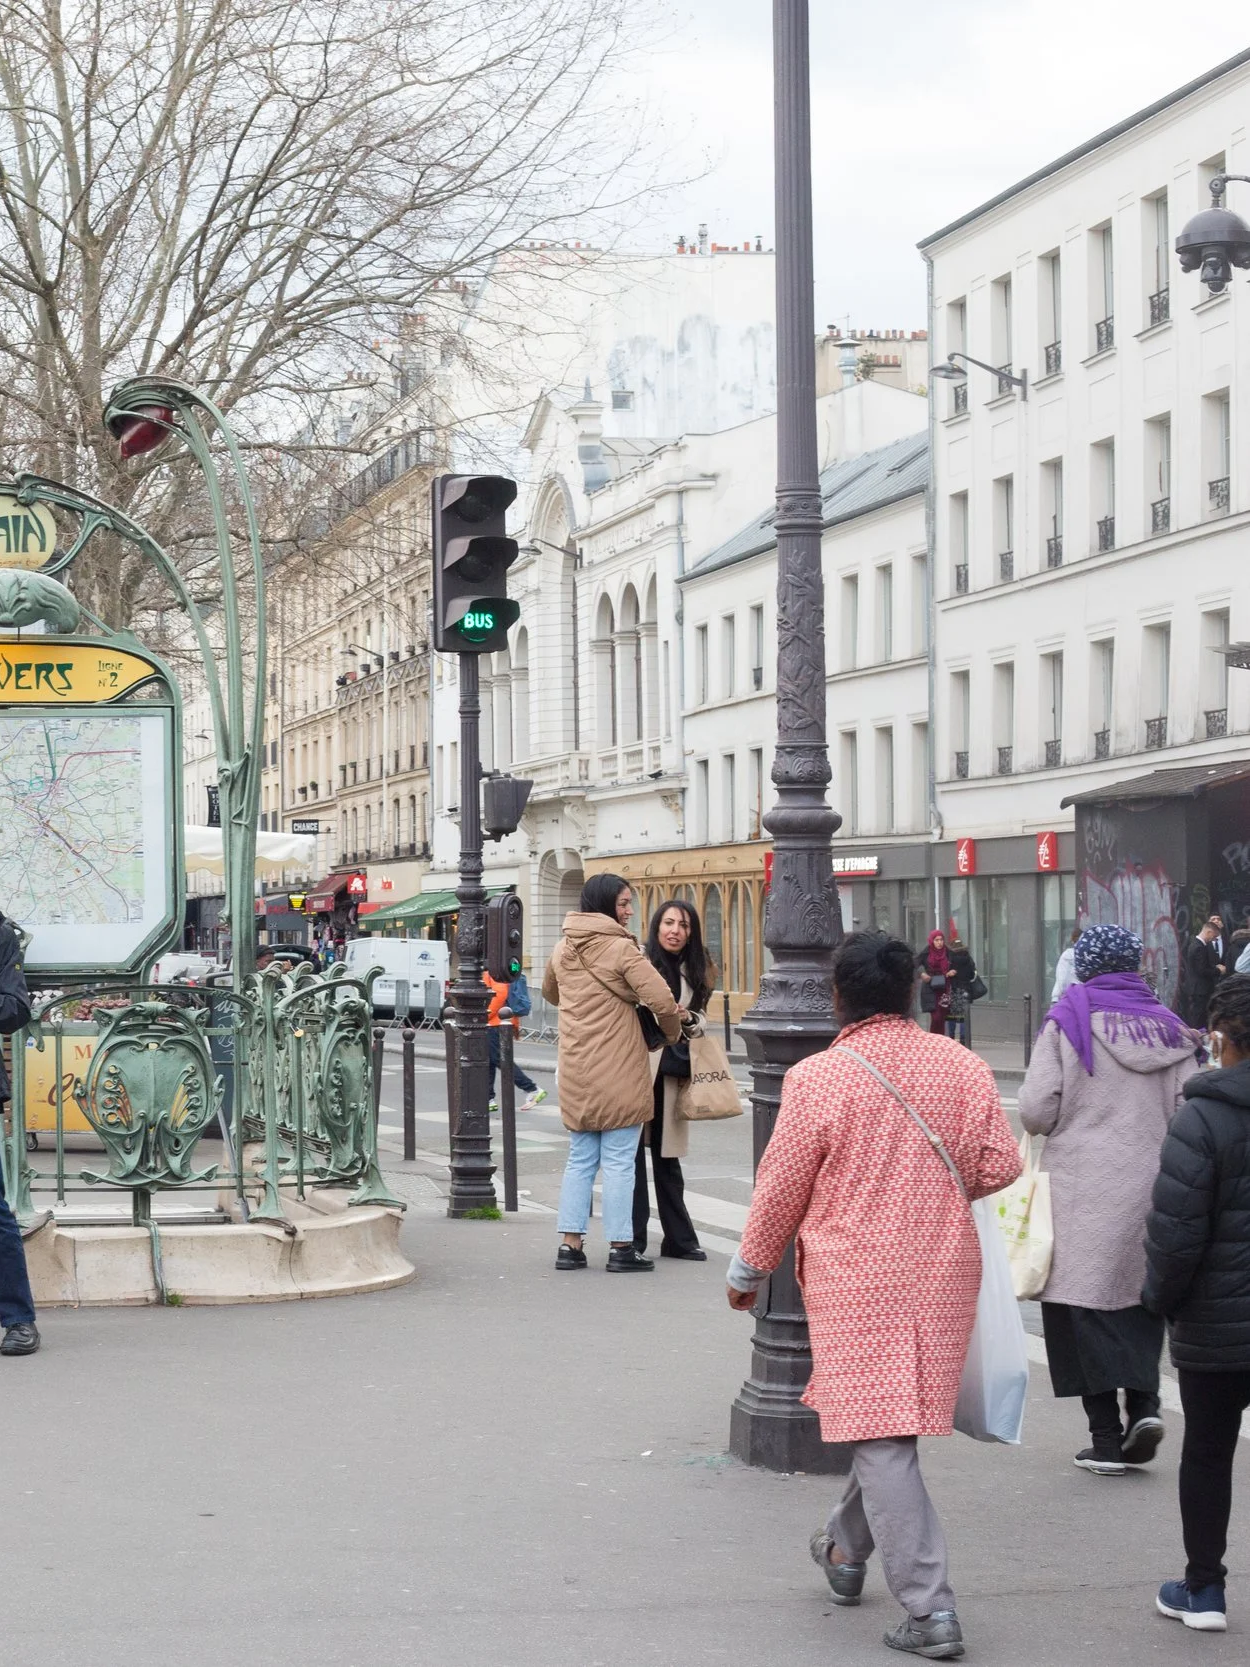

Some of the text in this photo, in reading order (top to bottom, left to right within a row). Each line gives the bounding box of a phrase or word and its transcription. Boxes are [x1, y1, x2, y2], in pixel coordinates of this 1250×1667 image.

[464, 613, 493, 629] BUS
[109, 672, 118, 687] 2
[294, 822, 318, 832] CHANGE
[832, 858, 845, 872] SSE
